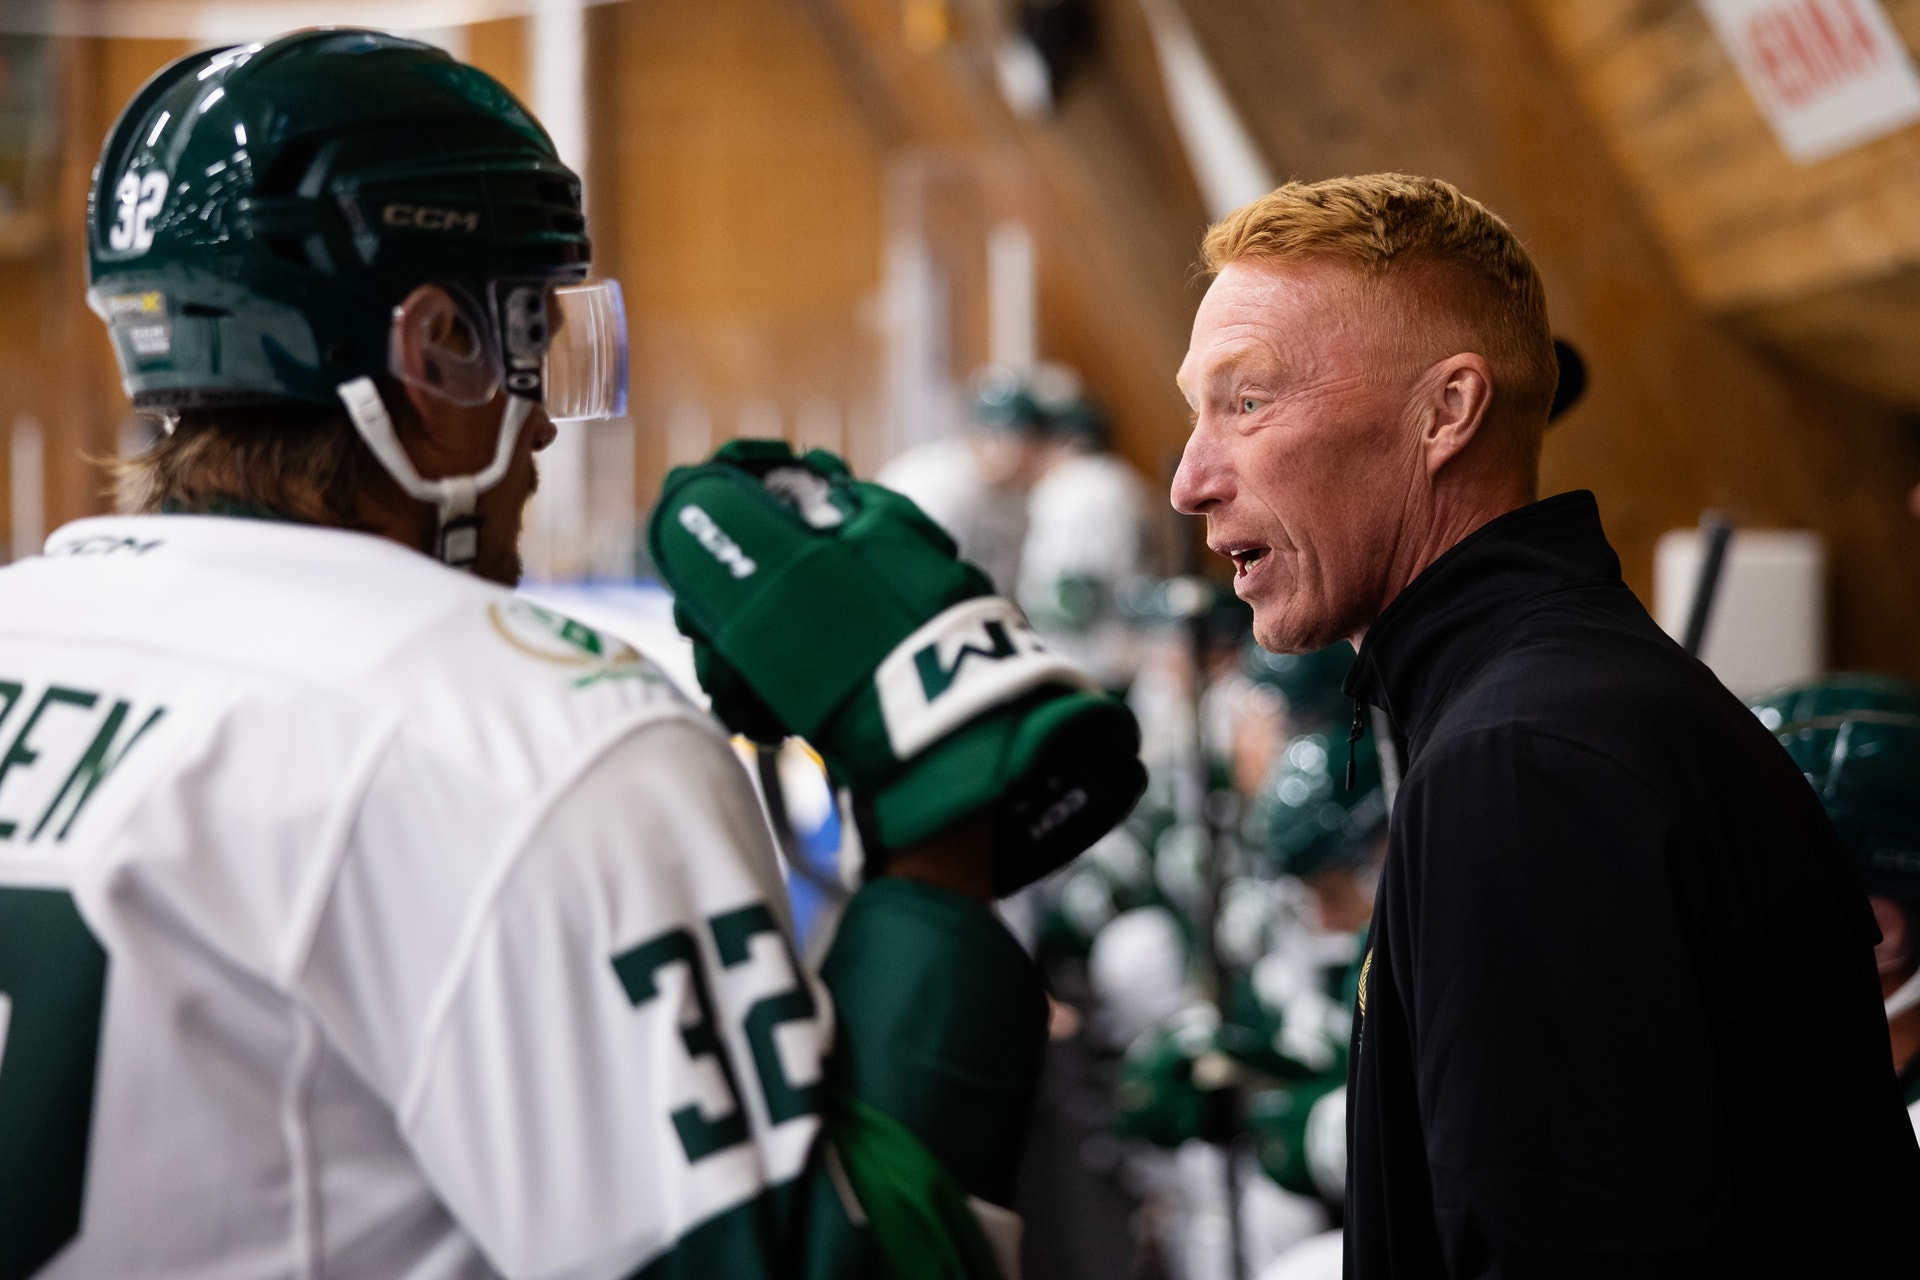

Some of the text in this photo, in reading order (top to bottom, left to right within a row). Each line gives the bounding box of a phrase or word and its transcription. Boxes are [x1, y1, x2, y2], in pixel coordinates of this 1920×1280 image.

[110, 169, 170, 251] 32
[382, 203, 481, 232] CCM
[678, 504, 758, 580] CCM
[610, 902, 827, 1166] 32
